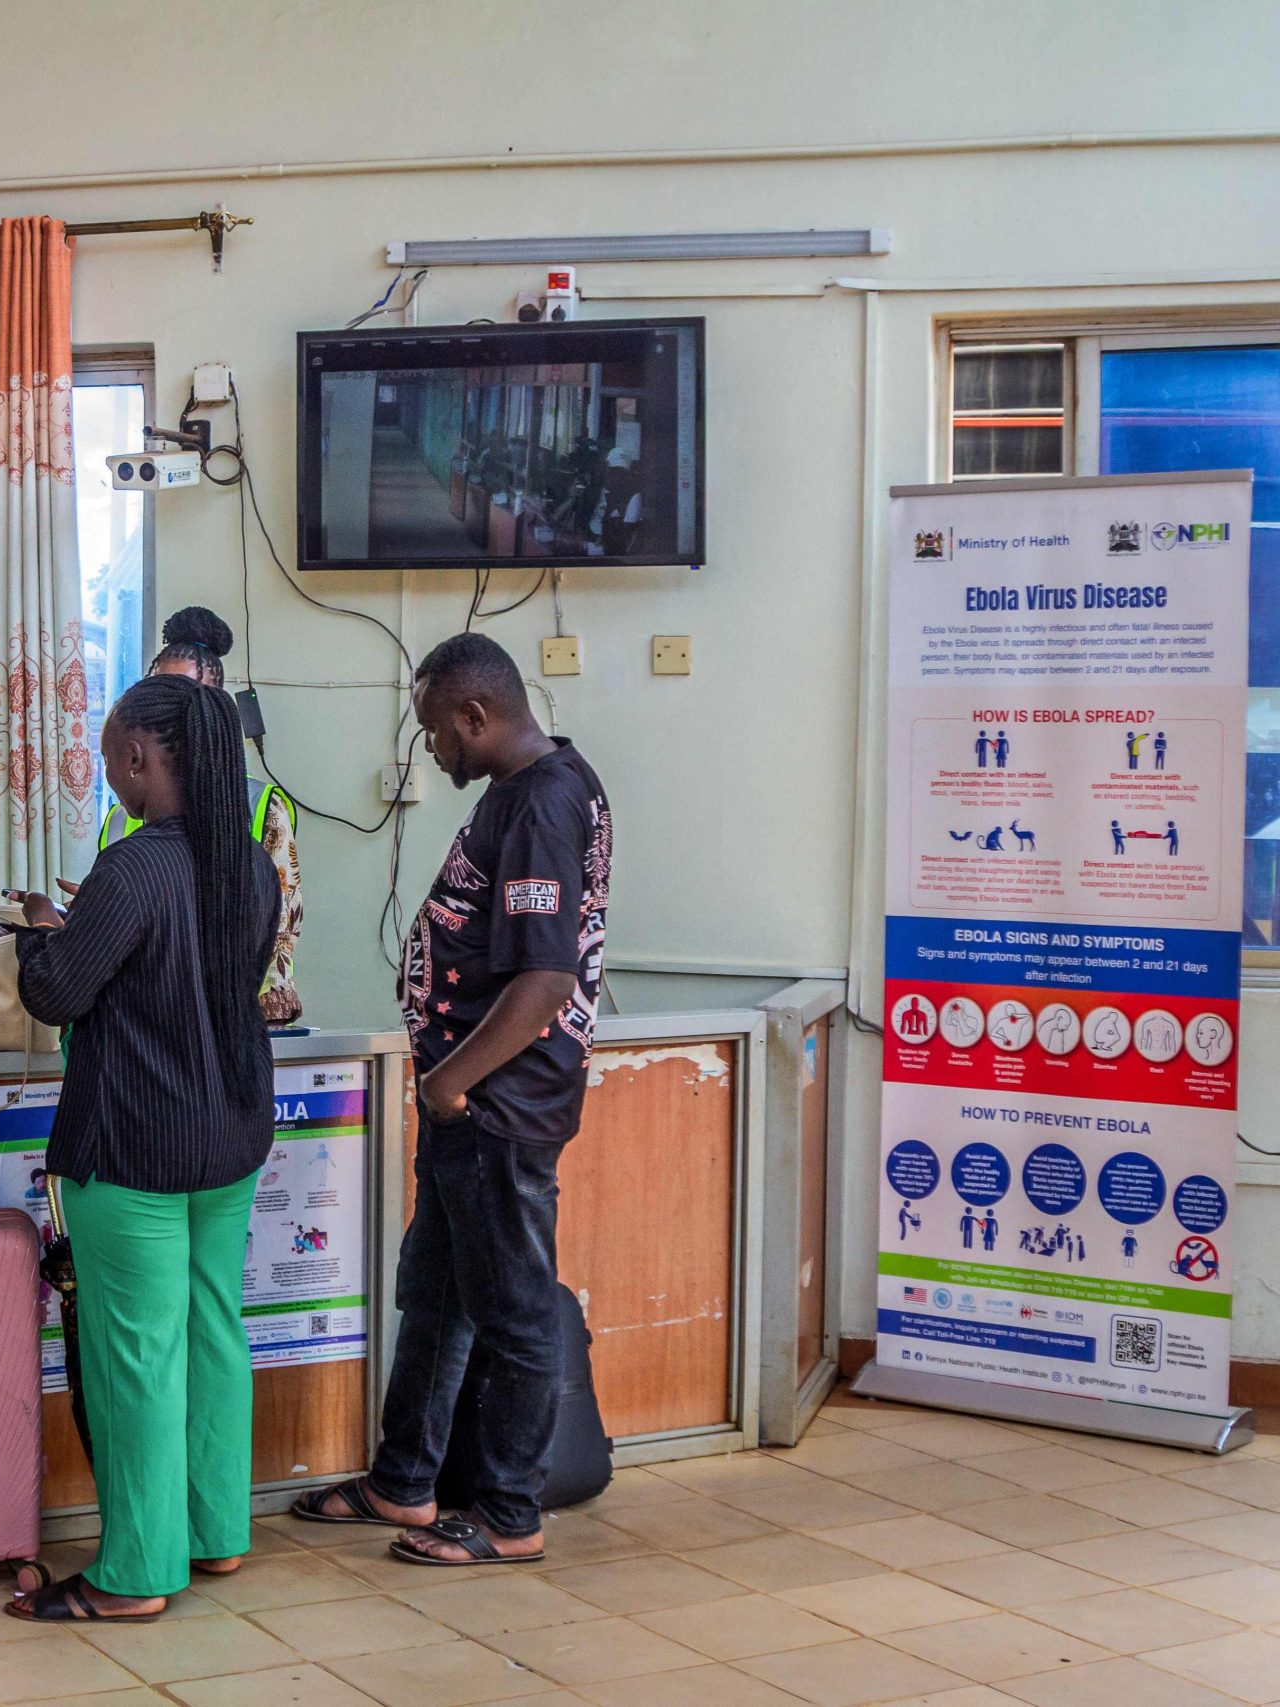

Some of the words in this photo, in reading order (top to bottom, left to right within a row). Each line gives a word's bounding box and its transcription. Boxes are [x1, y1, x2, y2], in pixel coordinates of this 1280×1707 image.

[959, 538, 1008, 551] Ministry
[1012, 535, 1025, 548] of
[1029, 534, 1070, 547] Health
[1178, 523, 1230, 542] NPHI
[966, 586, 1019, 611] Ebola
[1026, 584, 1077, 610] Virus
[1084, 583, 1167, 609] Disease
[923, 626, 945, 634] Ebola
[970, 625, 1002, 634] Disease
[1089, 623, 1105, 632] and
[1108, 622, 1129, 632] often
[1181, 621, 1213, 631] caused
[928, 640, 938, 649] by
[940, 640, 952, 648] the
[955, 639, 978, 648] Ebola
[1011, 638, 1045, 648] spreads
[1047, 638, 1078, 648] through
[1080, 637, 1104, 646] direct
[1106, 637, 1137, 646] contact
[1139, 637, 1157, 645] with
[1173, 636, 1206, 645] infected
[973, 652, 992, 662] body
[1033, 651, 1087, 660] contaminated
[1130, 651, 1152, 660] used
[1154, 651, 1165, 661] by
[1180, 650, 1214, 659] infected
[954, 666, 996, 676] Symptoms
[998, 668, 1016, 676] may
[1018, 667, 1048, 676] appear
[1049, 666, 1083, 674] between
[1093, 665, 1110, 673] and
[1112, 665, 1122, 673] 21
[1125, 665, 1147, 676] days
[1148, 665, 1169, 674] after
[973, 710, 1010, 723] HOW
[1014, 710, 1028, 723] IS
[1033, 710, 1081, 723] EBOLA
[1085, 710, 1155, 724] SPREAD?
[508, 882, 557, 897] AMERICAN
[509, 896, 556, 911] FIGHTER
[954, 929, 1002, 943] EBOLA
[1005, 931, 1048, 945] SIGNS
[1051, 933, 1080, 947] AND
[1083, 935, 1165, 952] SYMPTOMS
[917, 946, 945, 960] Signs
[947, 949, 966, 959] and
[968, 950, 1022, 963] symptoms
[1024, 954, 1045, 966] may
[1047, 955, 1083, 968] appear
[1085, 956, 1130, 968] between
[1132, 958, 1140, 968] 2
[1142, 959, 1163, 970] and
[1166, 960, 1179, 970] 21
[1183, 961, 1208, 975] days
[1025, 969, 1048, 981] after
[1050, 971, 1092, 983] infection
[24, 1091, 46, 1099] Ministry
[274, 1101, 309, 1122] OLA
[274, 1123, 296, 1131] ention
[961, 1106, 996, 1121] HOW
[1000, 1109, 1020, 1123] TO
[1024, 1112, 1092, 1130] PREVENT
[1097, 1118, 1151, 1135] EBOLA
[901, 1315, 912, 1323] For
[1065, 1313, 1084, 1322] IOM
[925, 1354, 947, 1364] Kenya
[948, 1357, 975, 1368] National
[976, 1361, 997, 1371] Public
[999, 1365, 1021, 1375] Health
